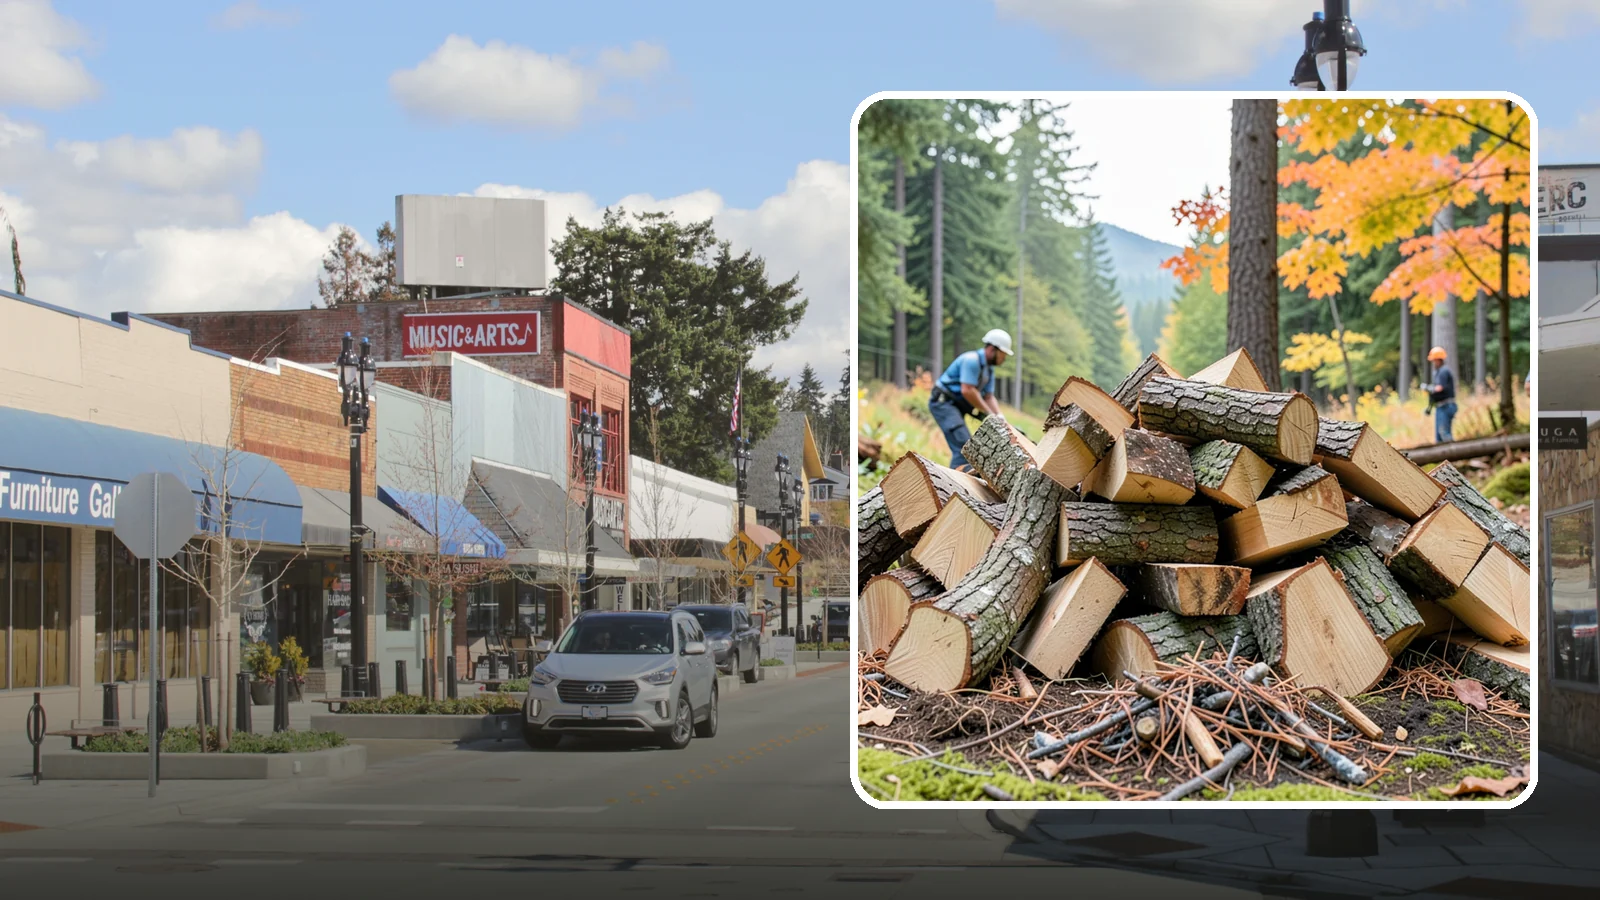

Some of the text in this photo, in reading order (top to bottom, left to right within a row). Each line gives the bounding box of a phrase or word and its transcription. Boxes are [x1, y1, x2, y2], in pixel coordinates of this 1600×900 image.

[1540, 427, 1577, 437] UGA
[1552, 436, 1580, 445] Framing
[0, 471, 80, 515] Furniture
[453, 563, 480, 574] SUSHI
